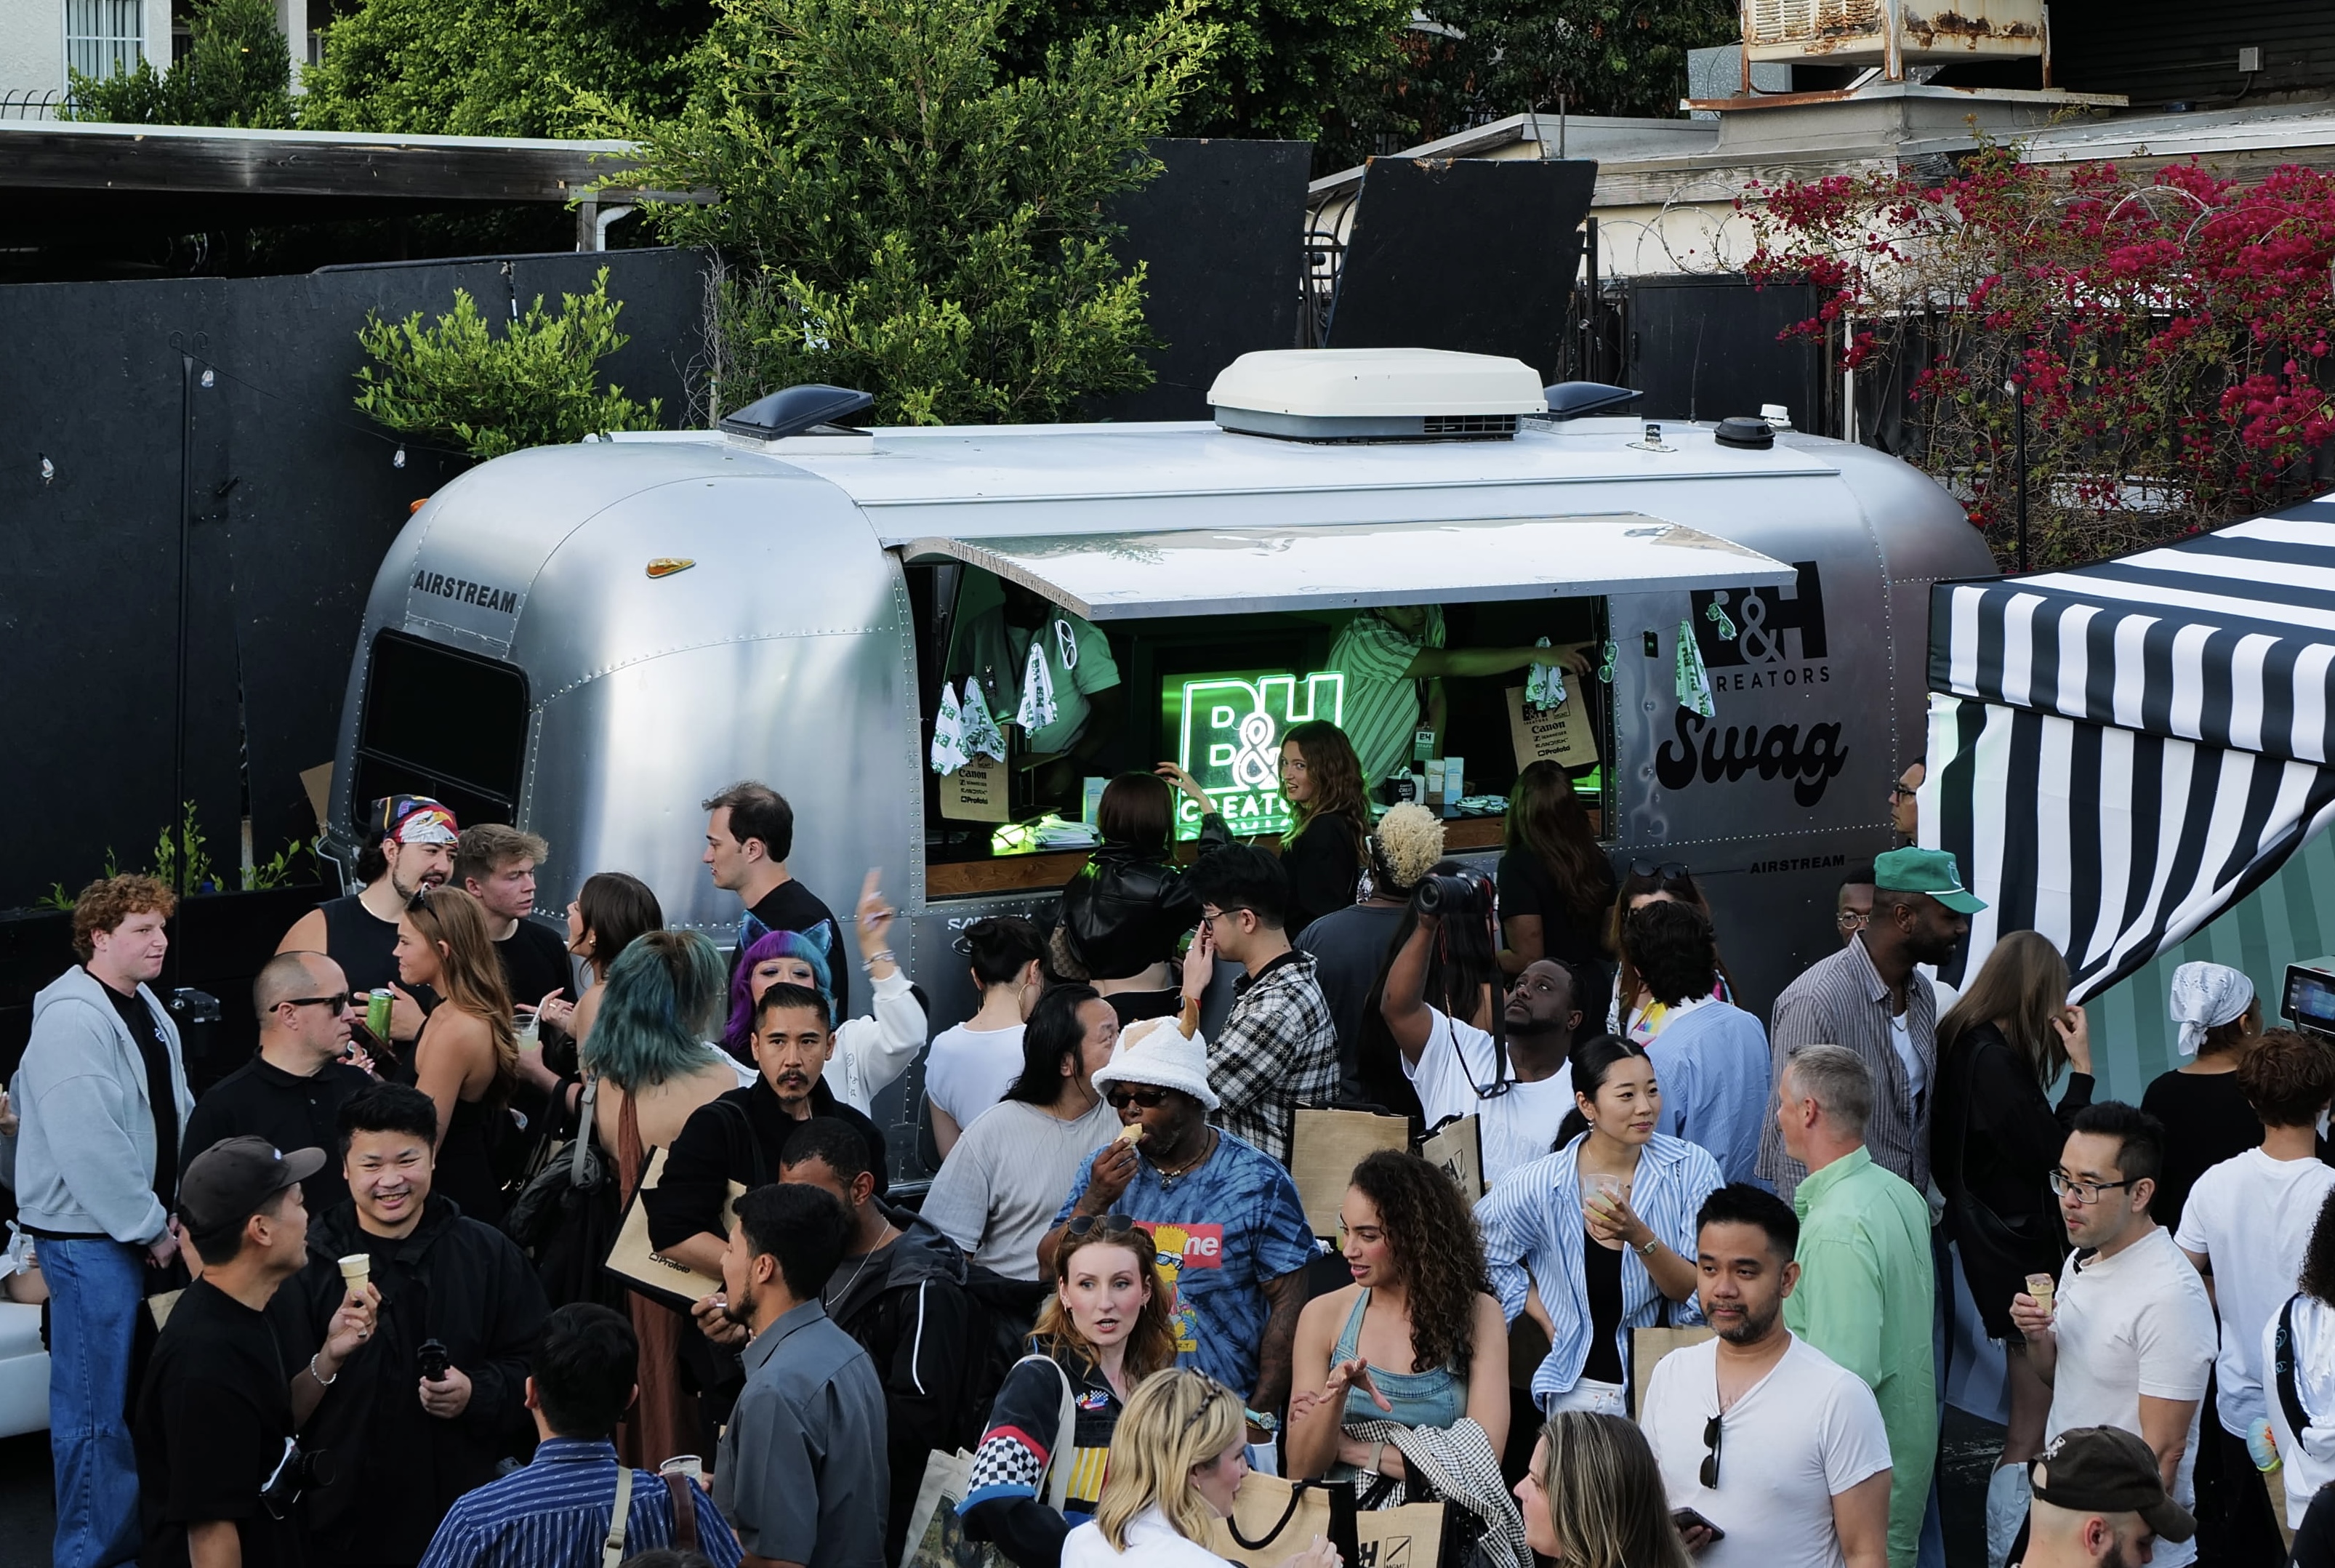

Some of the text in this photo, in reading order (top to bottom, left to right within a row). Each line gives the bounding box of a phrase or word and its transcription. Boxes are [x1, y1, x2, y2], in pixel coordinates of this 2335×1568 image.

[413, 570, 518, 614] AIRSTREAM
[1708, 667, 1830, 691] REATORS
[1532, 721, 1566, 733] Canon
[1546, 745, 1570, 755] Profoto
[1656, 704, 1849, 807] Swag
[959, 769, 987, 779] Canon
[1751, 855, 1845, 874] AIRSTREAM
[658, 1256, 691, 1274] Profoto
